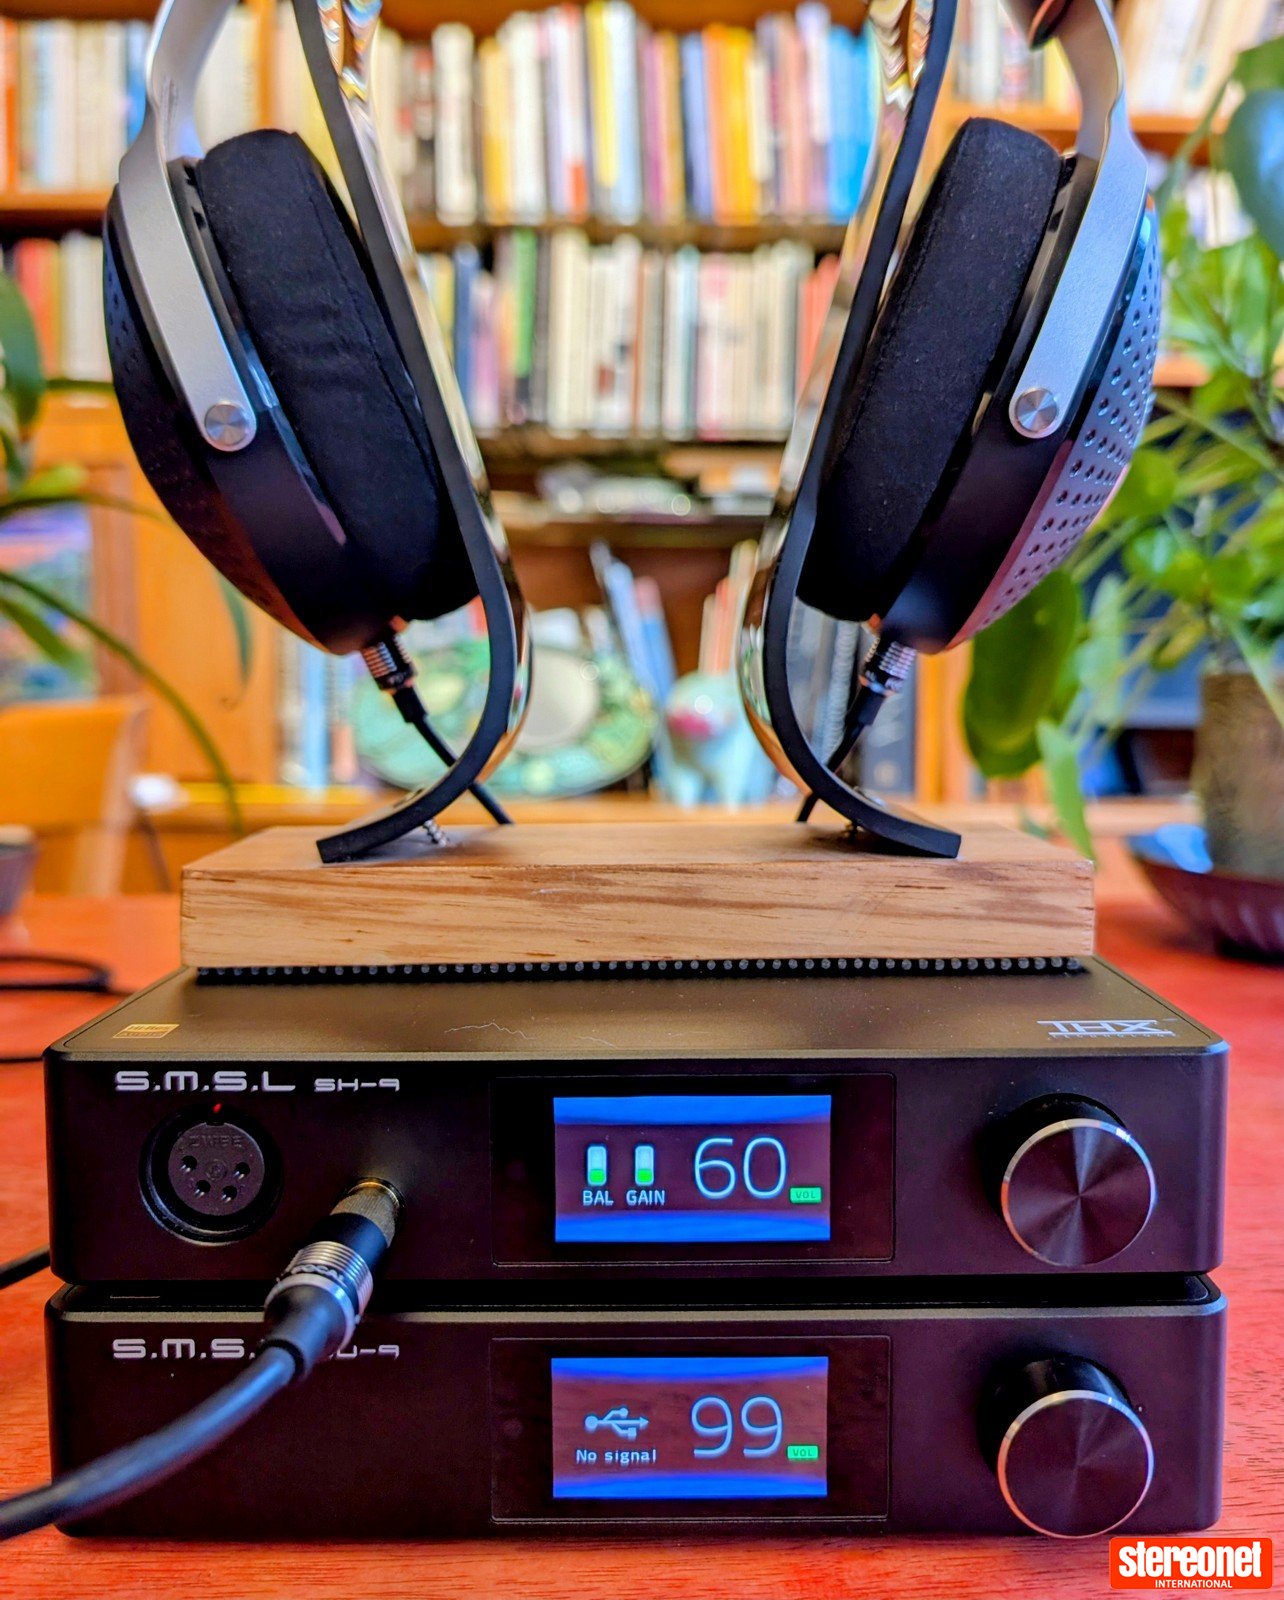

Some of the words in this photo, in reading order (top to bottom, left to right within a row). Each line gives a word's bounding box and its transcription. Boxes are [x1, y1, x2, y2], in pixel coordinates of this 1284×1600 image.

[1037, 1019, 1175, 1035] THX
[114, 1070, 296, 1092] S.M.S.L
[313, 1077, 400, 1092] SH-9
[694, 1137, 787, 1199] 60
[582, 1190, 614, 1206] BAL
[626, 1190, 665, 1206] GAIN
[795, 1191, 816, 1200] VOL
[112, 1338, 262, 1360] S.M.S.
[691, 1396, 783, 1458] 99
[576, 1449, 597, 1463] No
[604, 1449, 657, 1466] signal
[792, 1448, 813, 1457] VOL
